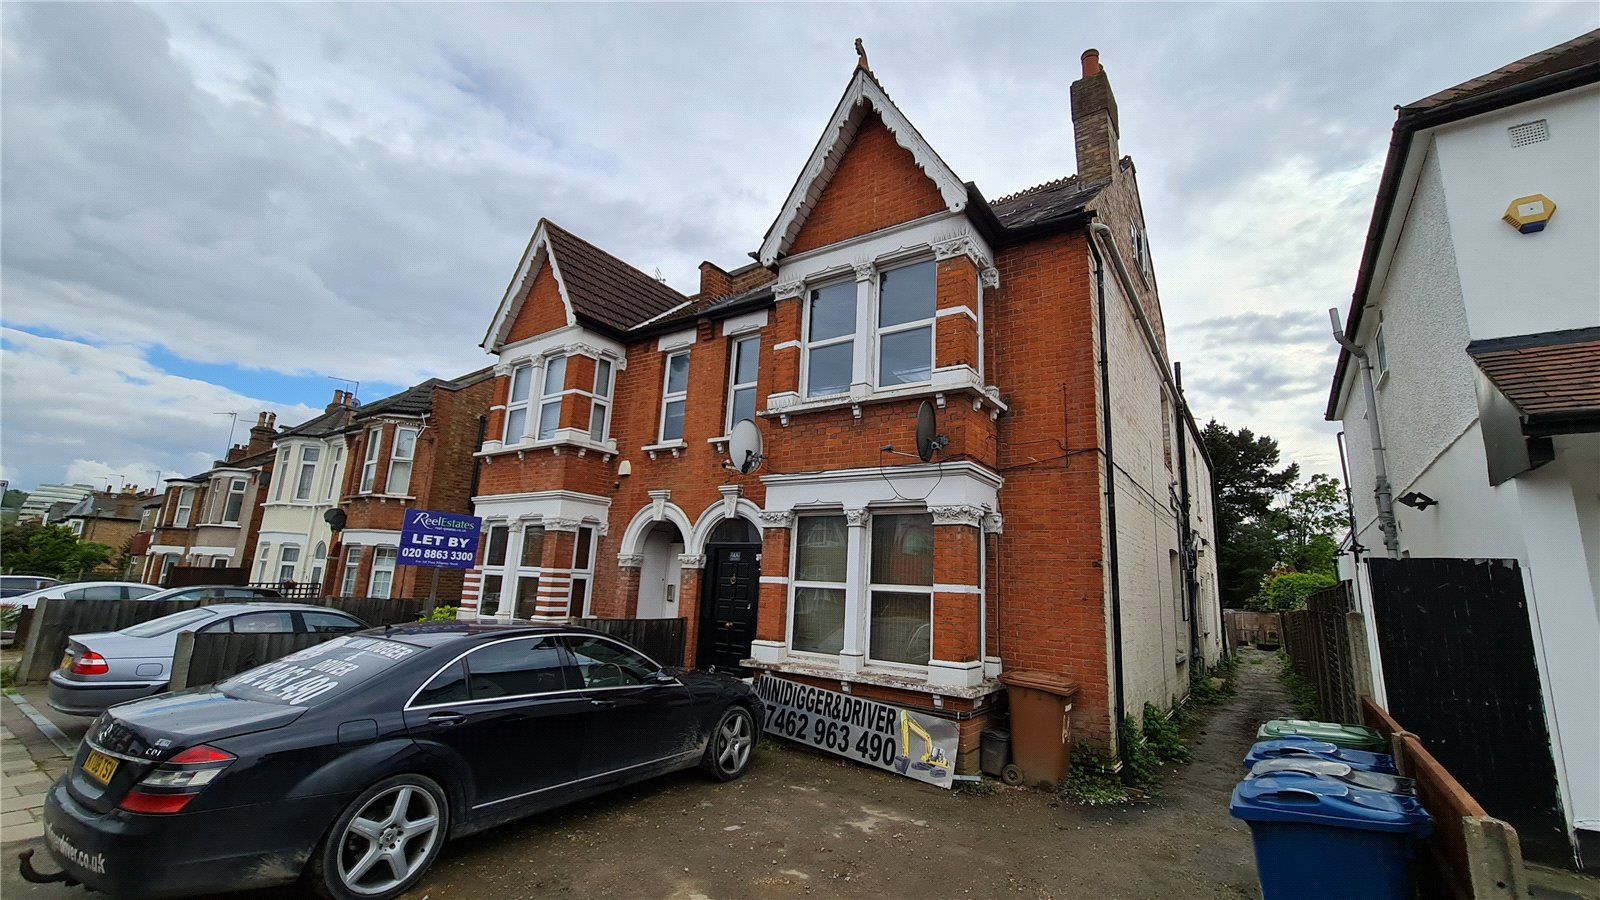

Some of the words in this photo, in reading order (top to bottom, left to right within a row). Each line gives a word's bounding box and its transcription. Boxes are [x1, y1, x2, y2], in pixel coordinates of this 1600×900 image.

[413, 512, 475, 530] ReelEstates
[412, 533, 445, 546] LET
[448, 537, 470, 548] BY
[402, 547, 422, 558] 020
[424, 549, 448, 560] 8863
[450, 551, 473, 561] 3300
[276, 674, 339, 706] 490
[813, 718, 850, 752] 963
[855, 730, 897, 766] 490
